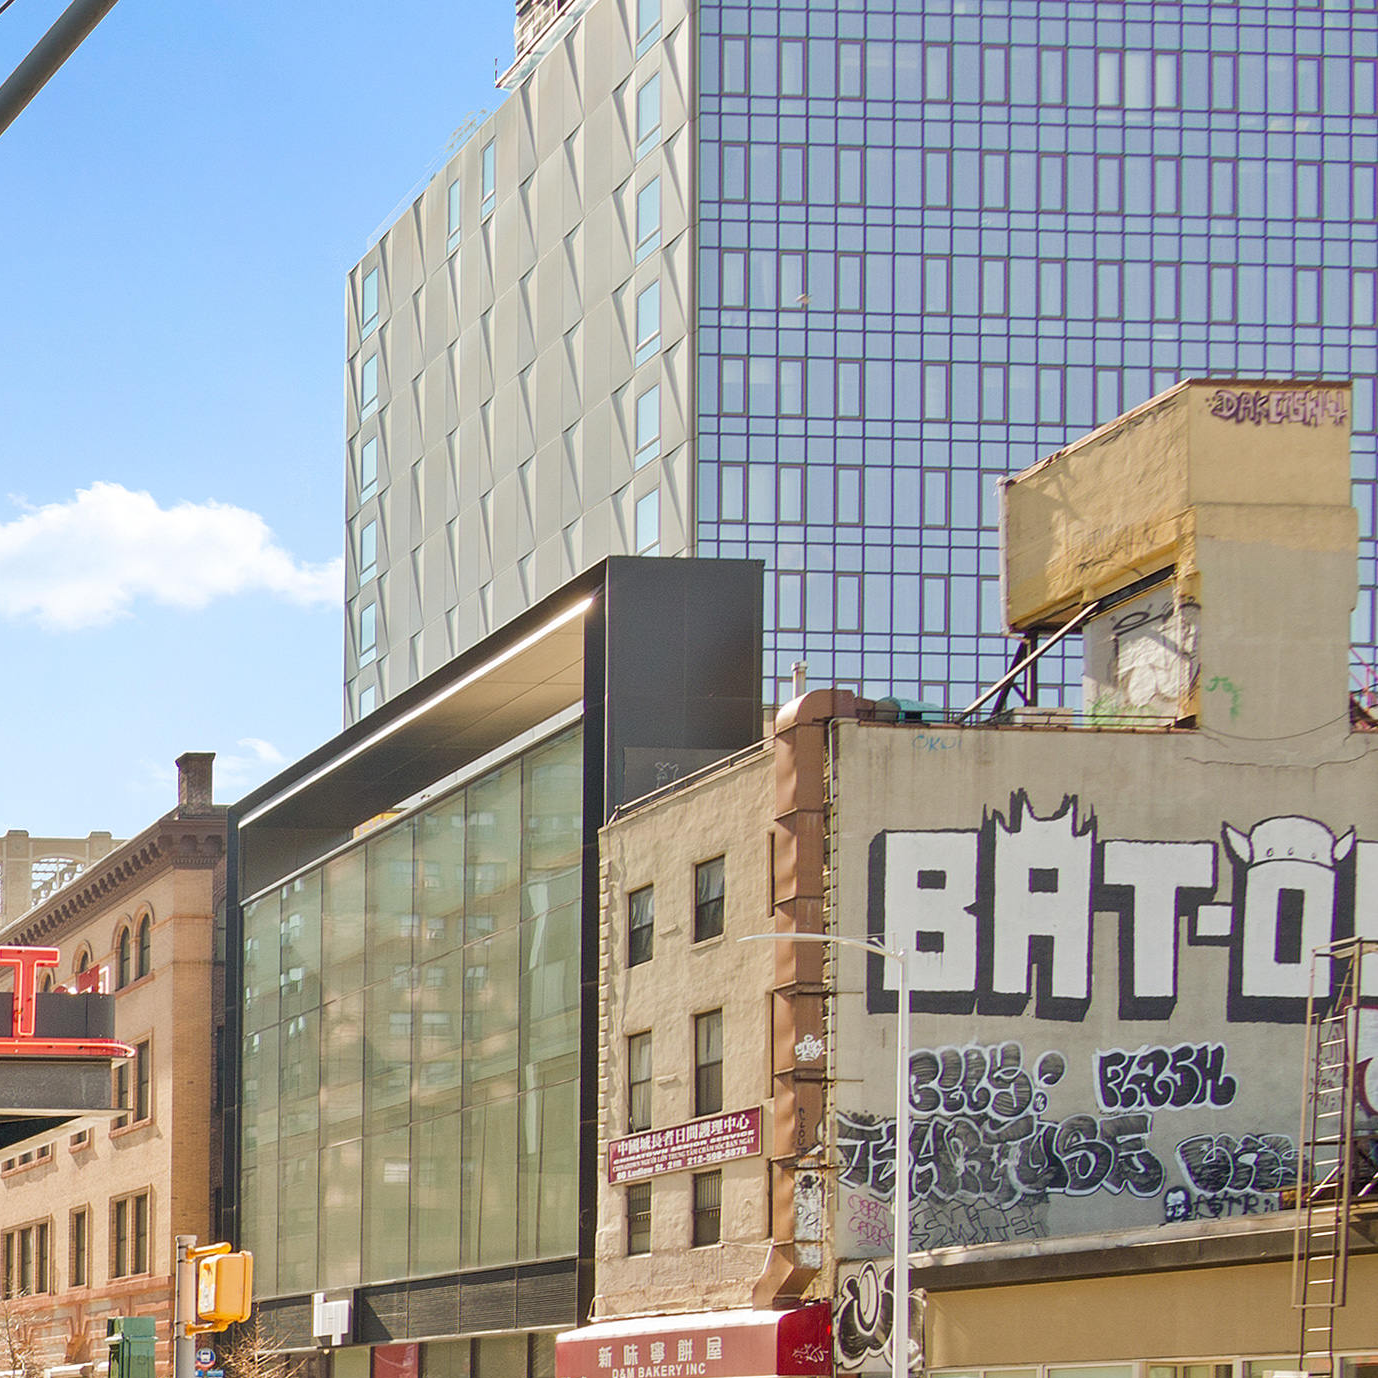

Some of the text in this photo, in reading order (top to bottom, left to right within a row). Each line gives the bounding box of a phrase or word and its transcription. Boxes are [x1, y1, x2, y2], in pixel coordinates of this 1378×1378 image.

[670, 1140, 708, 1152] SENIOR
[709, 1129, 755, 1144] SERVICE
[638, 1364, 684, 1378] BAKERY
[686, 1362, 706, 1376] INC
